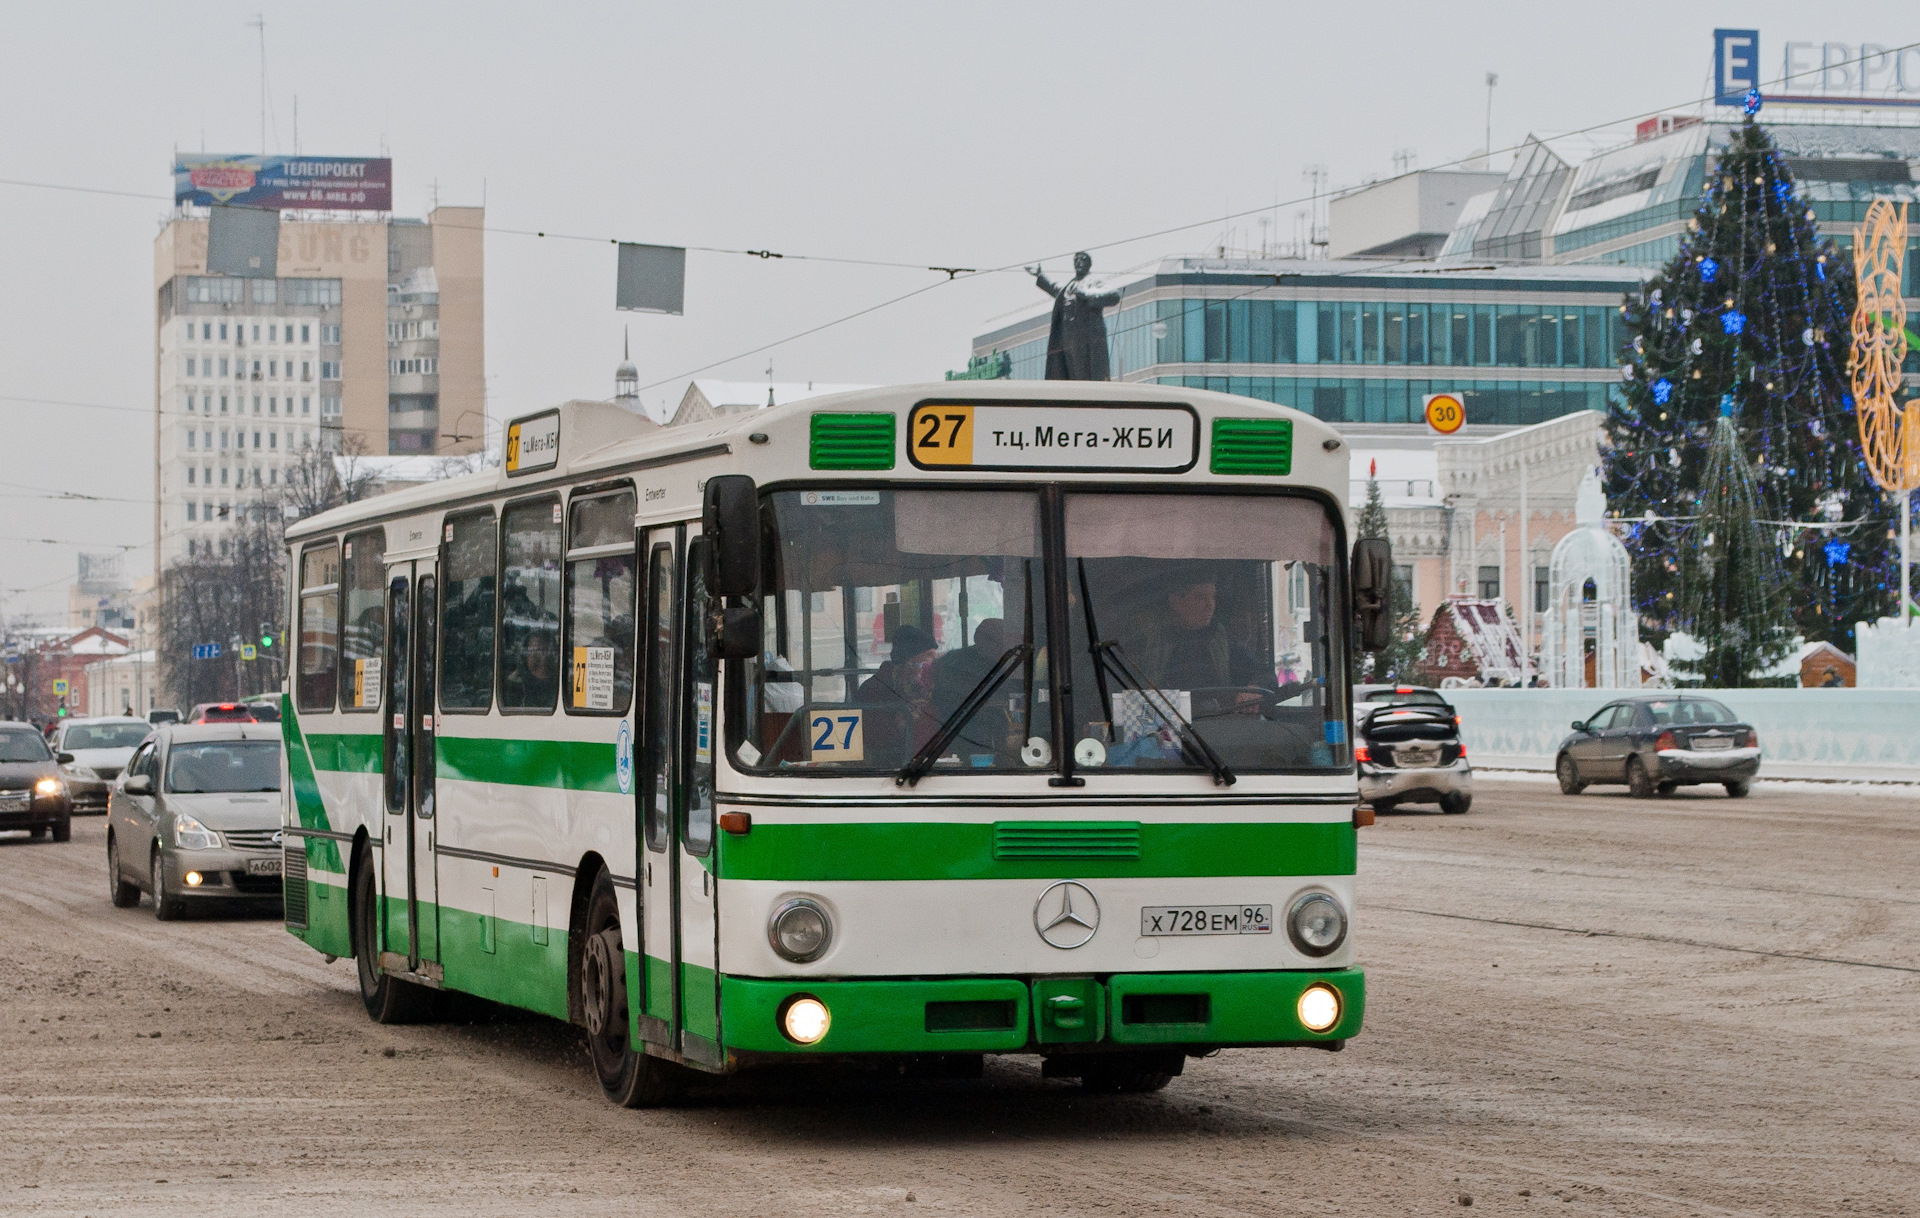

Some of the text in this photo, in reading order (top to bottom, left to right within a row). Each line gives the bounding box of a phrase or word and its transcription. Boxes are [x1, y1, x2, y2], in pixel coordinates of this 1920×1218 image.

[282, 161, 367, 177] ТЕЛЕПРОЕКТ
[1435, 406, 1456, 422] 30
[919, 414, 966, 448] 27
[507, 436, 520, 462] 27
[576, 662, 586, 693] 27
[812, 716, 859, 750] 27
[1243, 907, 1264, 924] 96
